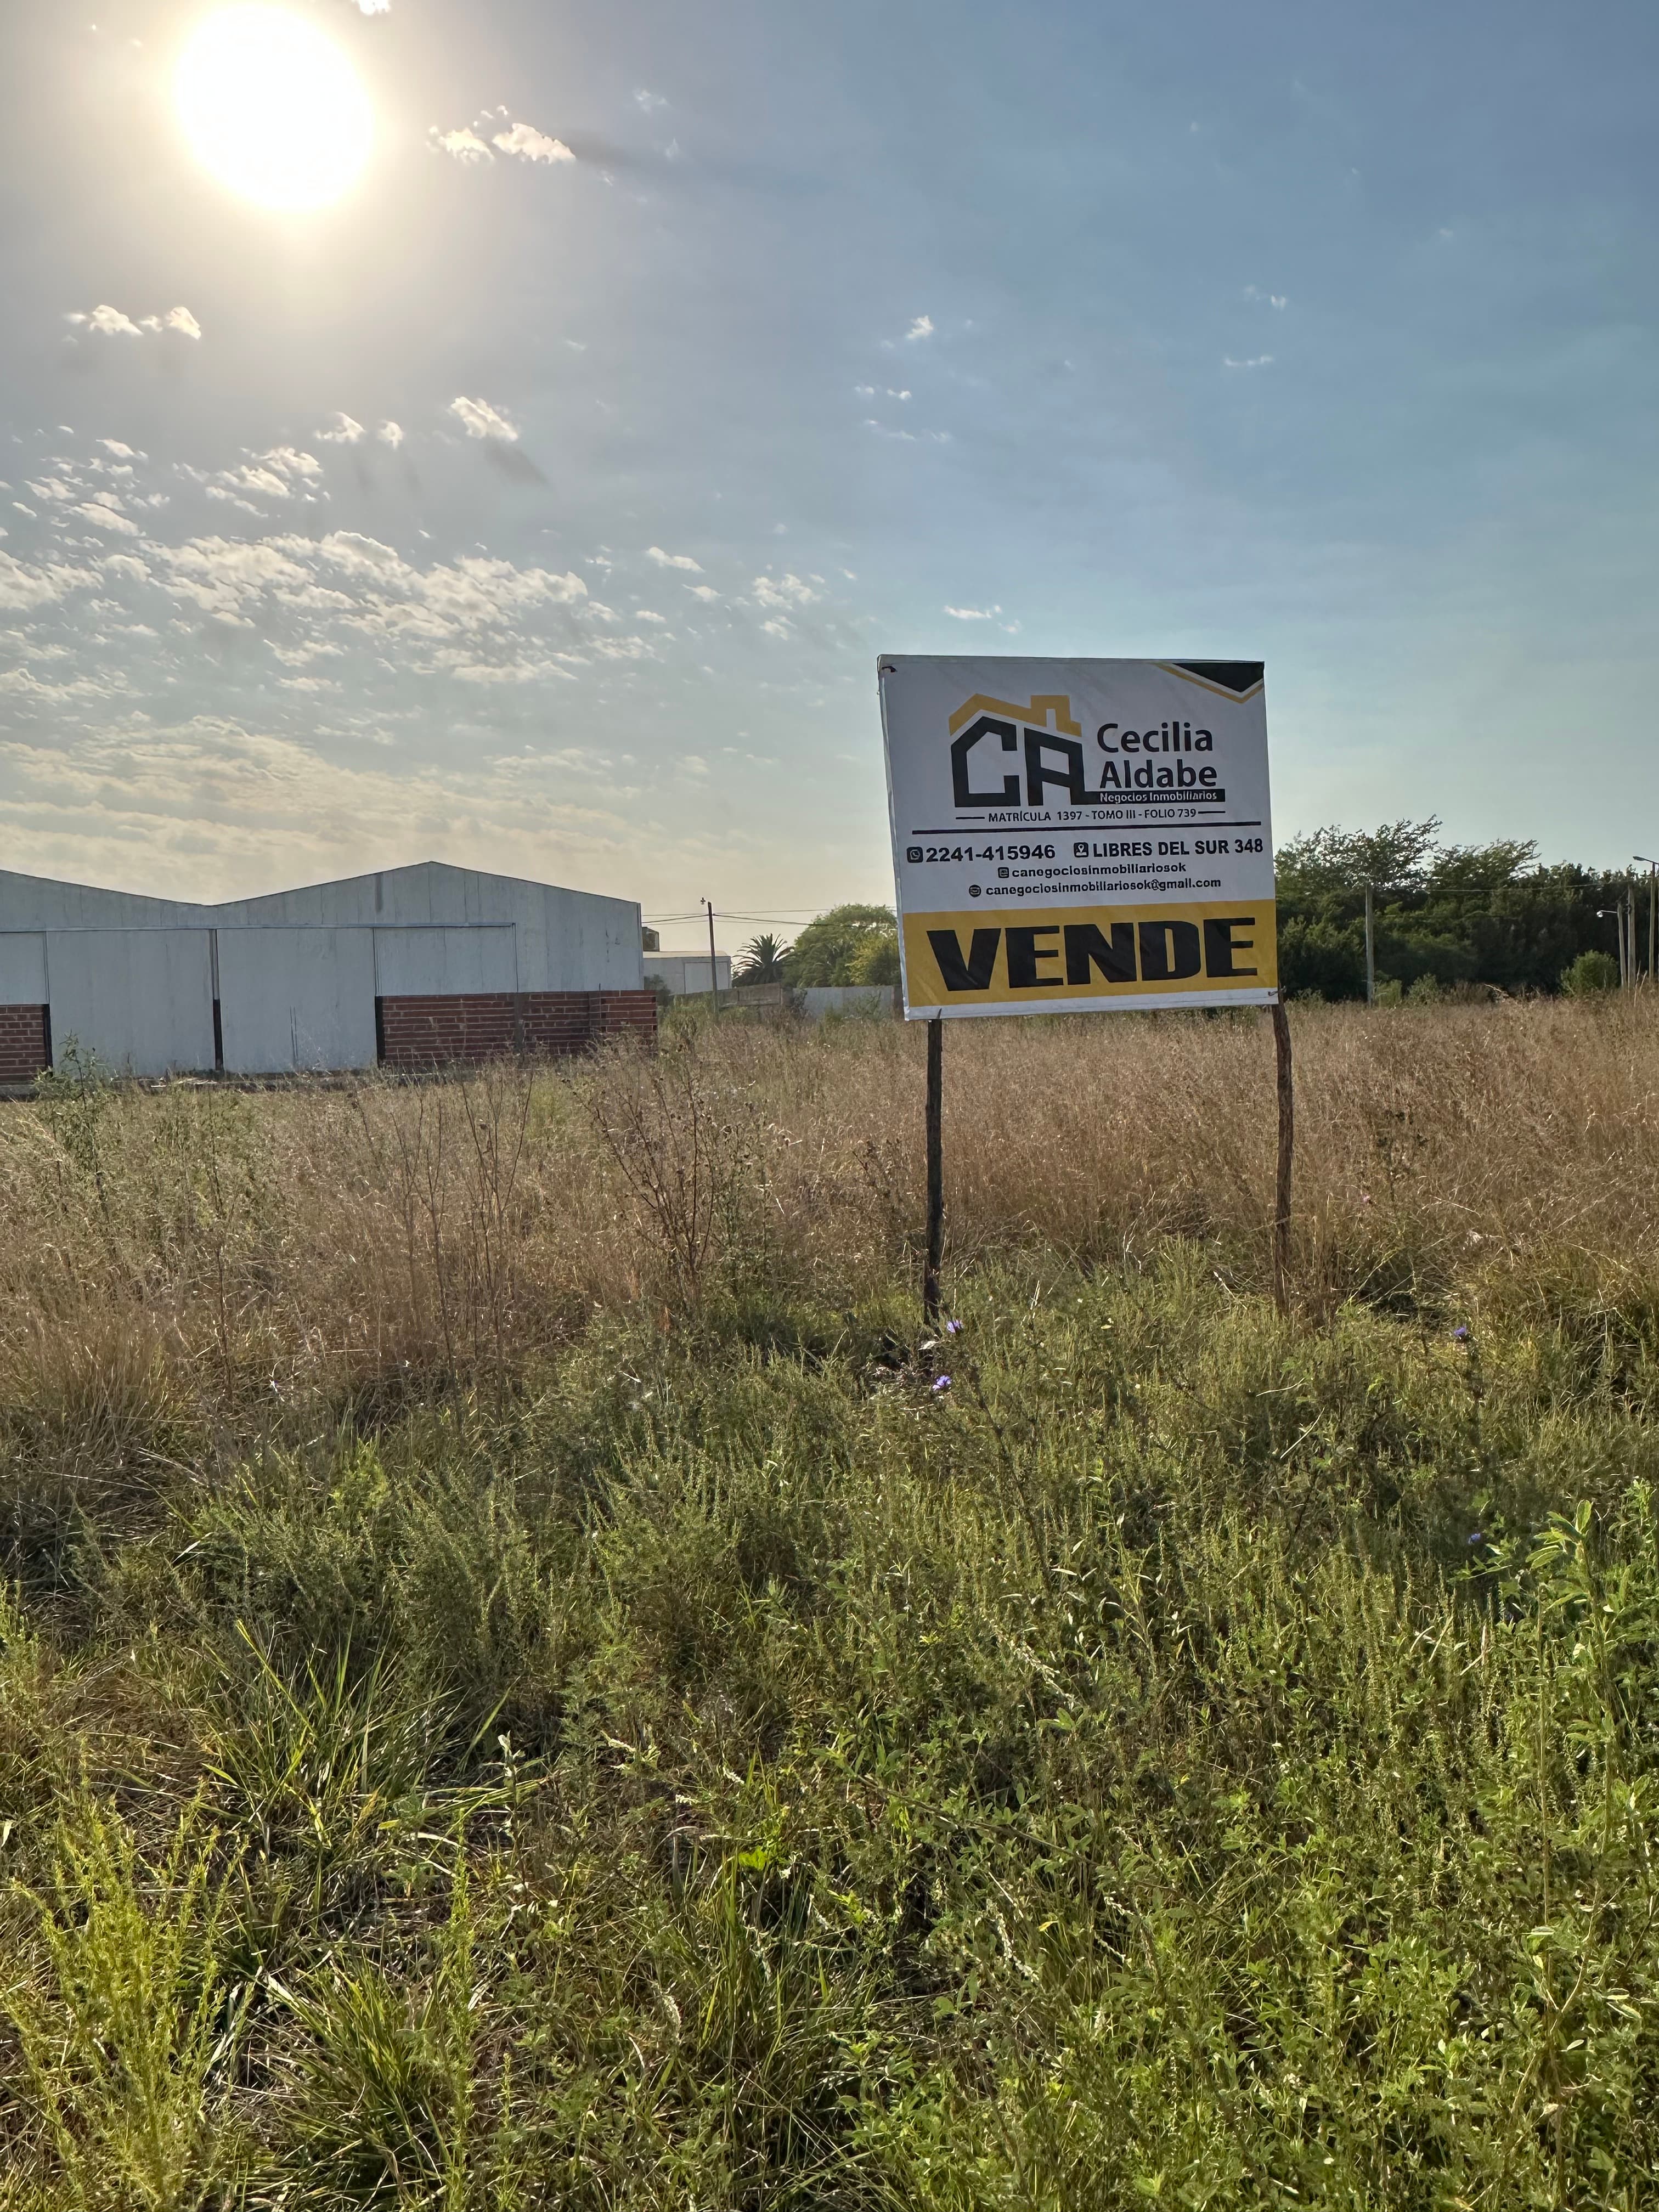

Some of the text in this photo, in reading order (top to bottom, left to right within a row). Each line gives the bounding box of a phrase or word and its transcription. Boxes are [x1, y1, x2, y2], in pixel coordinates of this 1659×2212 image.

[1097, 721, 1213, 753] Cecilia
[1099, 759, 1217, 788] Aldabe
[1100, 790, 1217, 804] Negocios Inmobiliarios
[989, 811, 1051, 822] MATRÍCULA
[1057, 811, 1082, 821] 1397
[1092, 810, 1123, 820] TOMO
[1126, 809, 1136, 819] III
[1144, 809, 1175, 818] FOLIO
[1178, 808, 1196, 817] 739
[926, 844, 1056, 862] 2241-415946
[1093, 838, 1263, 857] LIBRES DEL SUR 348
[926, 917, 1259, 992] VENDE
